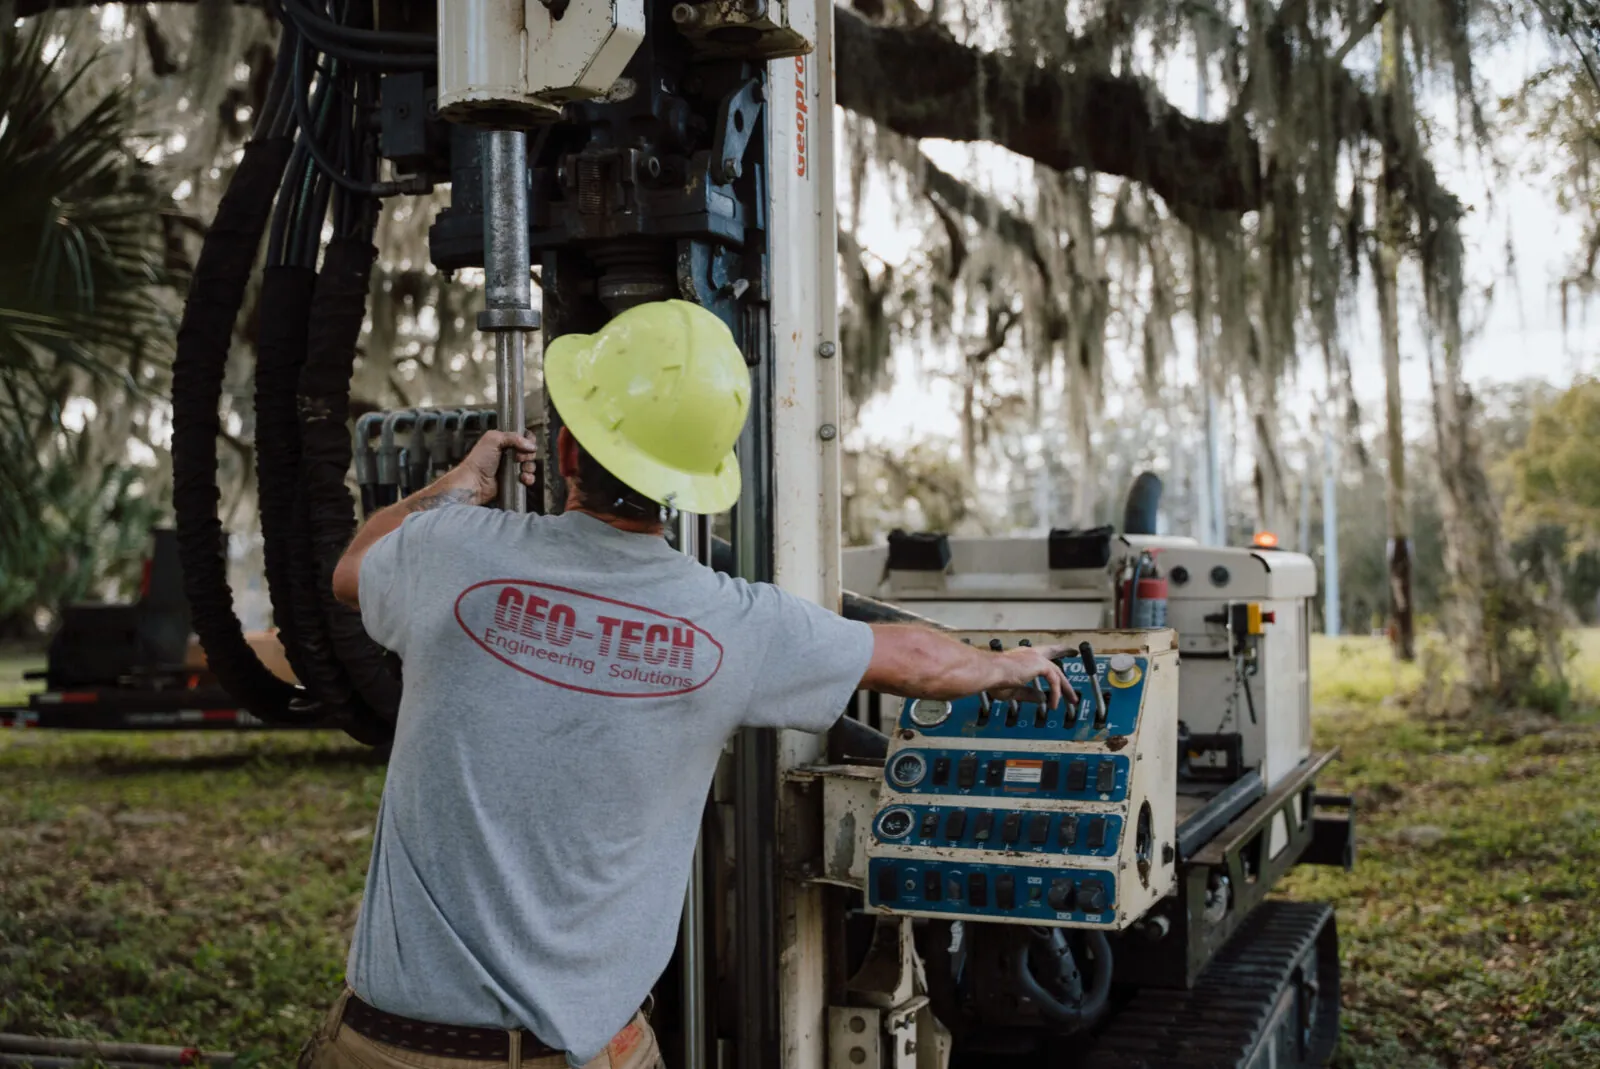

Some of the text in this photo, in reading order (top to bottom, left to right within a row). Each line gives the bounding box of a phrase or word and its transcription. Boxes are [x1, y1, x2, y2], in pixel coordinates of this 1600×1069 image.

[484, 628, 695, 689] Engineering Solutions
[494, 586, 695, 670] GEO-TECH
[1063, 662, 1106, 674] roe
